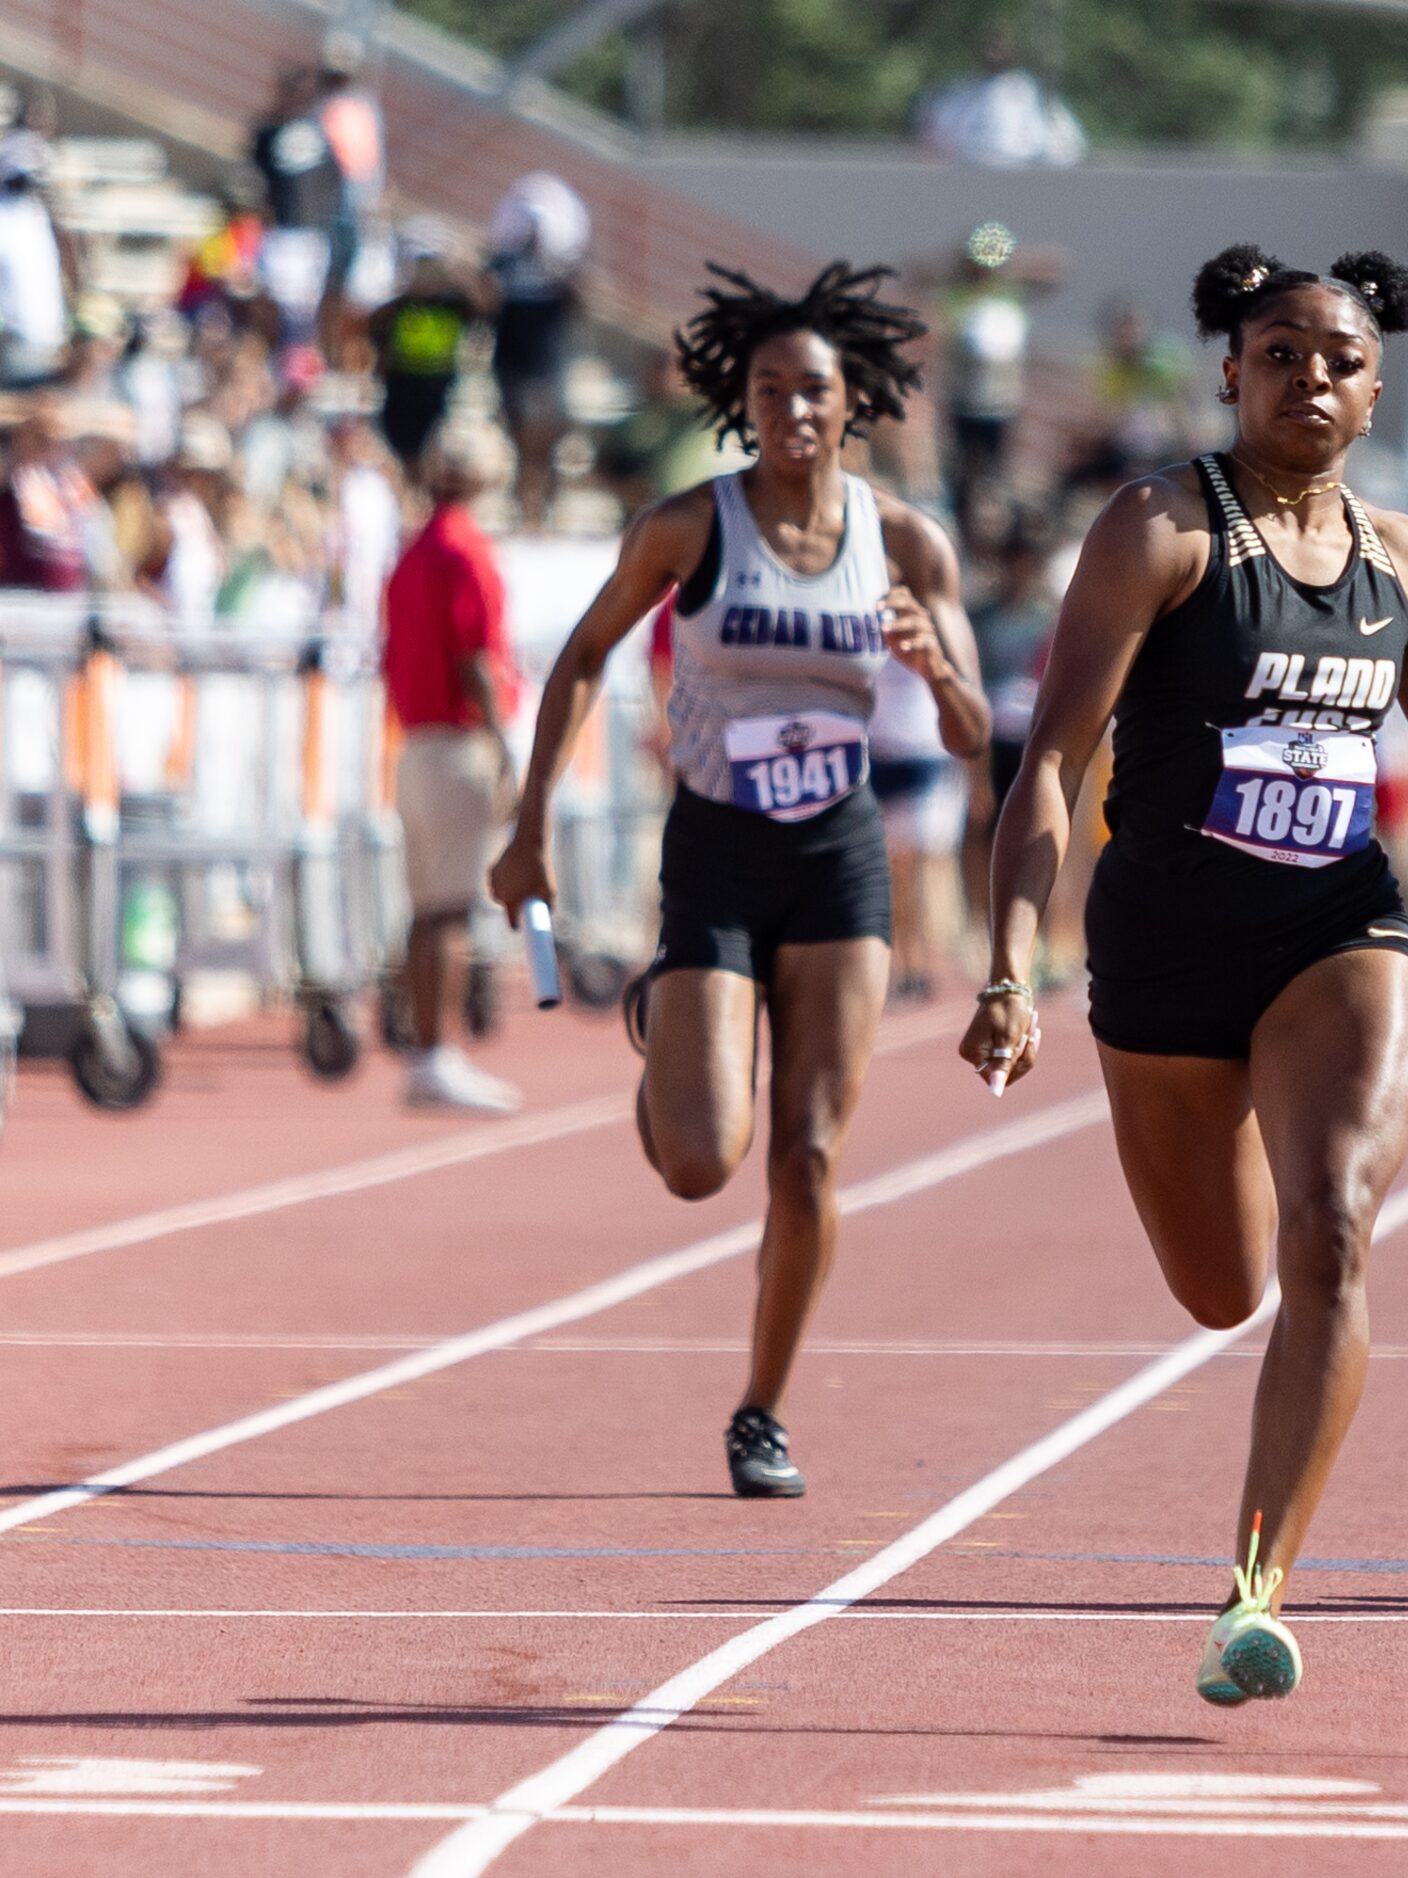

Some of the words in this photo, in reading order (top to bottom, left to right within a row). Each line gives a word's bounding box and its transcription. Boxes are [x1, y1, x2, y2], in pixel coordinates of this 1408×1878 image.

[1245, 652, 1395, 710] PLANO
[748, 746, 850, 811] 1941
[1283, 749, 1328, 765] STATE
[1236, 778, 1356, 849] 1897
[1270, 851, 1299, 864] 2022
